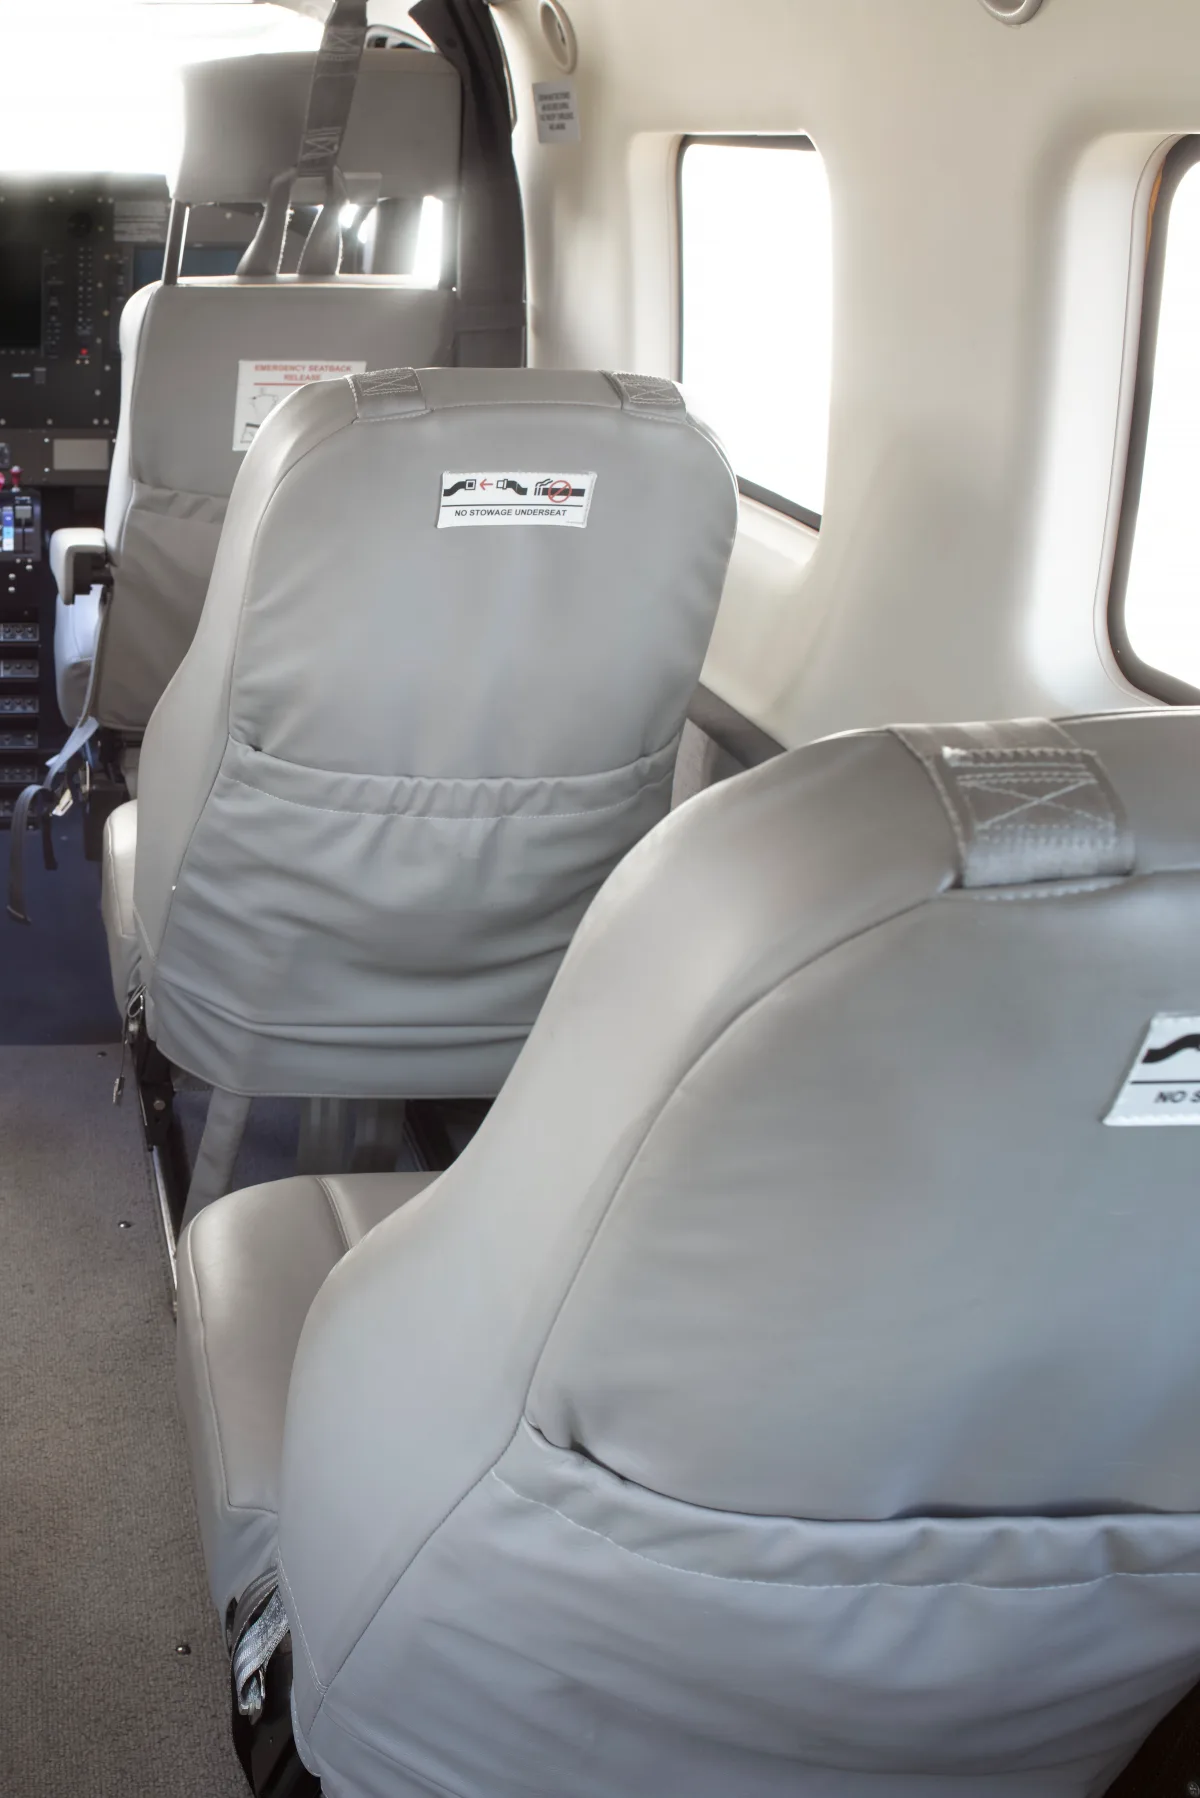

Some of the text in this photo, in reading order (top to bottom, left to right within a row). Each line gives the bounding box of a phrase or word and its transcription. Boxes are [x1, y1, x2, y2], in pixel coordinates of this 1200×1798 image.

[254, 364, 352, 372] EMERGENCY SEATBACK
[454, 508, 567, 517] NO STOWAGE UNDERSEAT
[1153, 1090, 1186, 1103] NO
